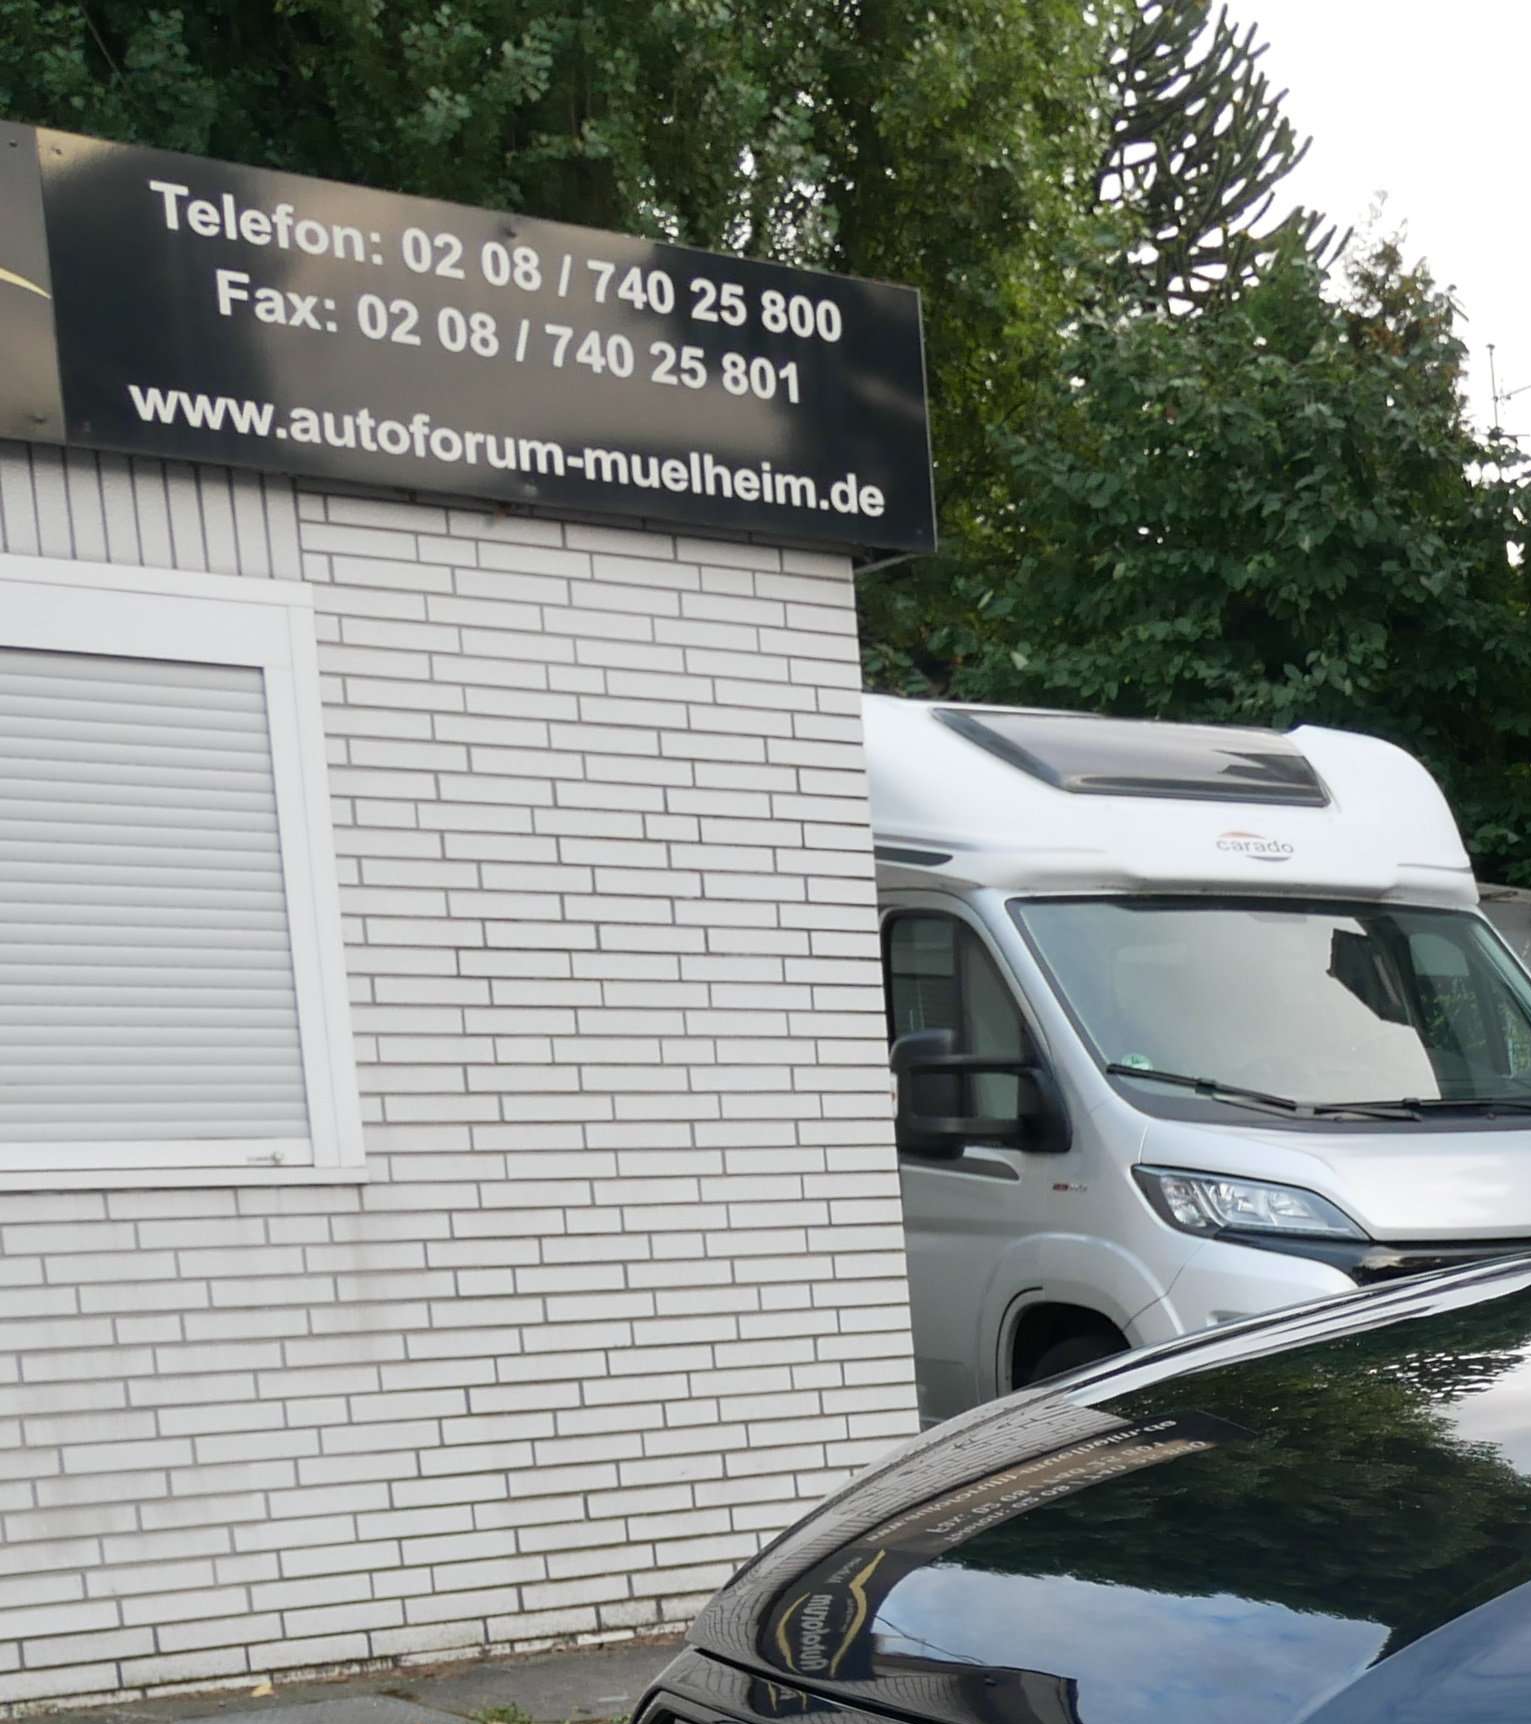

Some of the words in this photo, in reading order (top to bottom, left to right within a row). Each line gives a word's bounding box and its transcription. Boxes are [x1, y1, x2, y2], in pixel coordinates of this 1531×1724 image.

[148, 180, 384, 266] Telefon:
[401, 226, 466, 280] 02
[480, 241, 543, 293] 08
[557, 253, 574, 298] /
[587, 258, 676, 315] 740
[690, 278, 748, 326] 25
[760, 290, 843, 342] 800
[215, 269, 337, 332] Fax:
[357, 293, 422, 346] 02
[437, 306, 500, 358] 08
[515, 318, 530, 363] /
[544, 323, 636, 378] 740
[649, 341, 708, 389] 25
[721, 352, 801, 404] 801
[128, 384, 885, 518] www.autoforum-muelheim.de
[1215, 839, 1295, 854] carado
